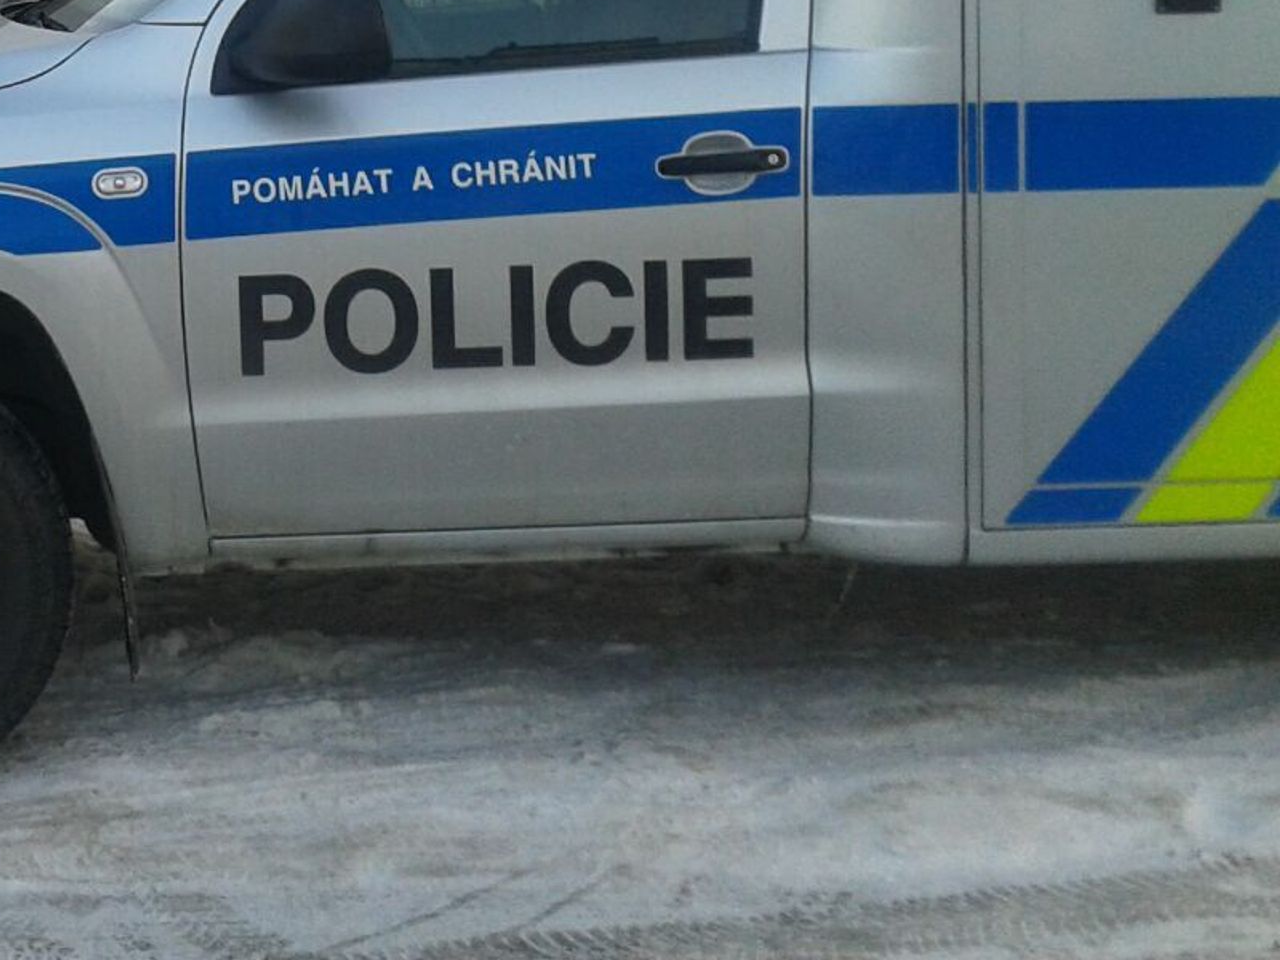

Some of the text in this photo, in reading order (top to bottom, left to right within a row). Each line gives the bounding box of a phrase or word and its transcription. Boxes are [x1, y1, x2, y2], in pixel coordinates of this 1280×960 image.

[231, 150, 597, 206] POMÁHAT A CHRÁNIT
[237, 256, 755, 377] POLICIE
